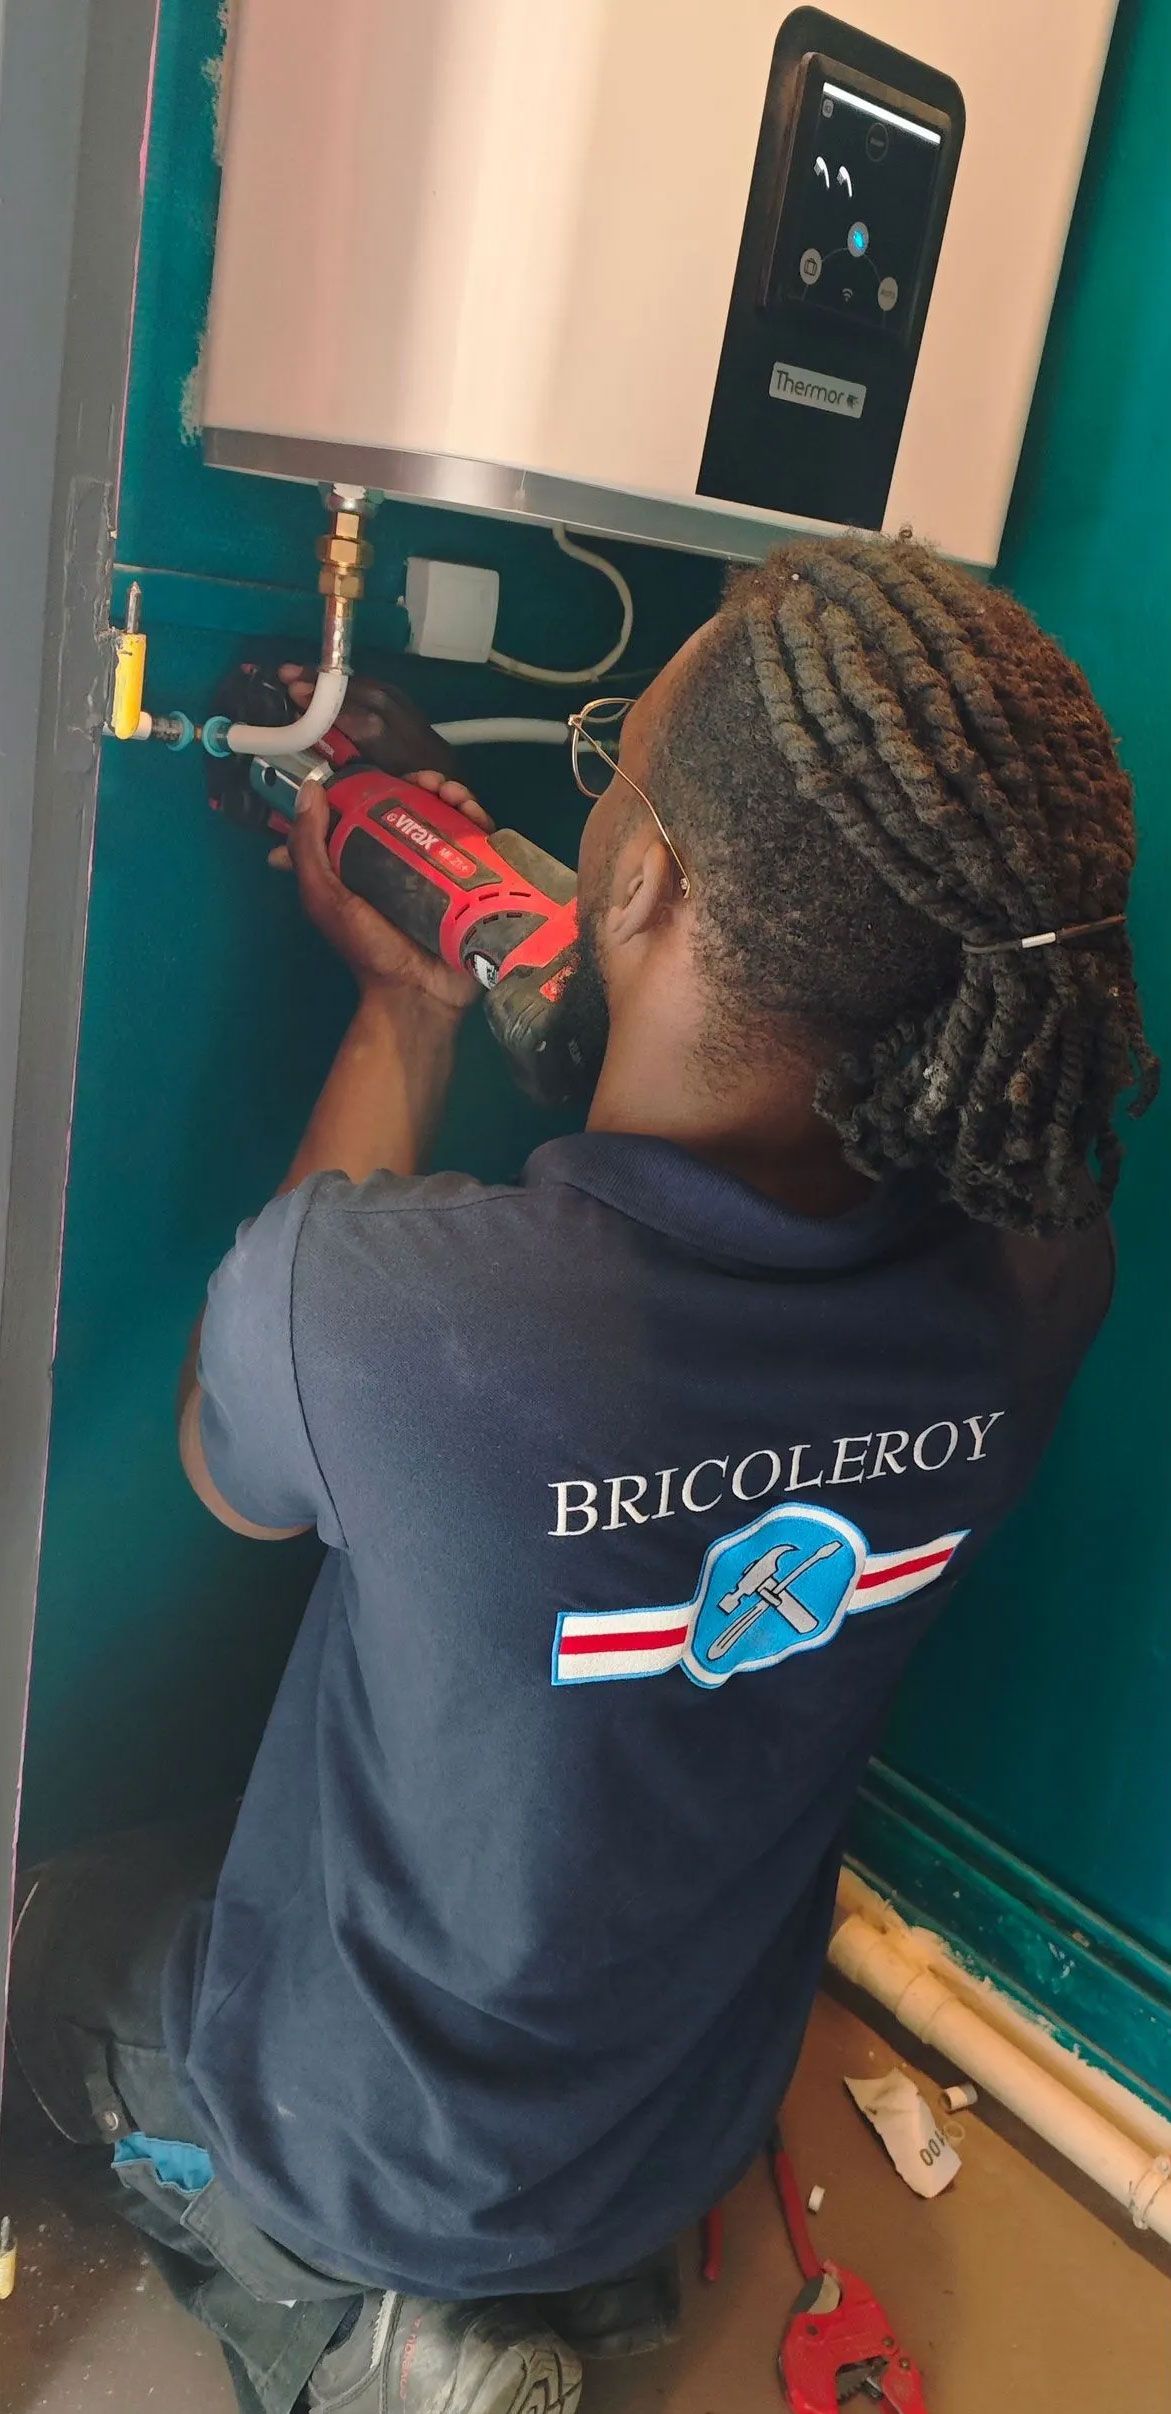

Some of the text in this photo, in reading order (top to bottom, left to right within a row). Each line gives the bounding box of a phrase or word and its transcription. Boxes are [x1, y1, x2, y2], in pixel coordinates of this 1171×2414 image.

[776, 370, 845, 405] Thermor
[395, 813, 440, 850] virax
[546, 1410, 1006, 1538] BRICOLEROY
